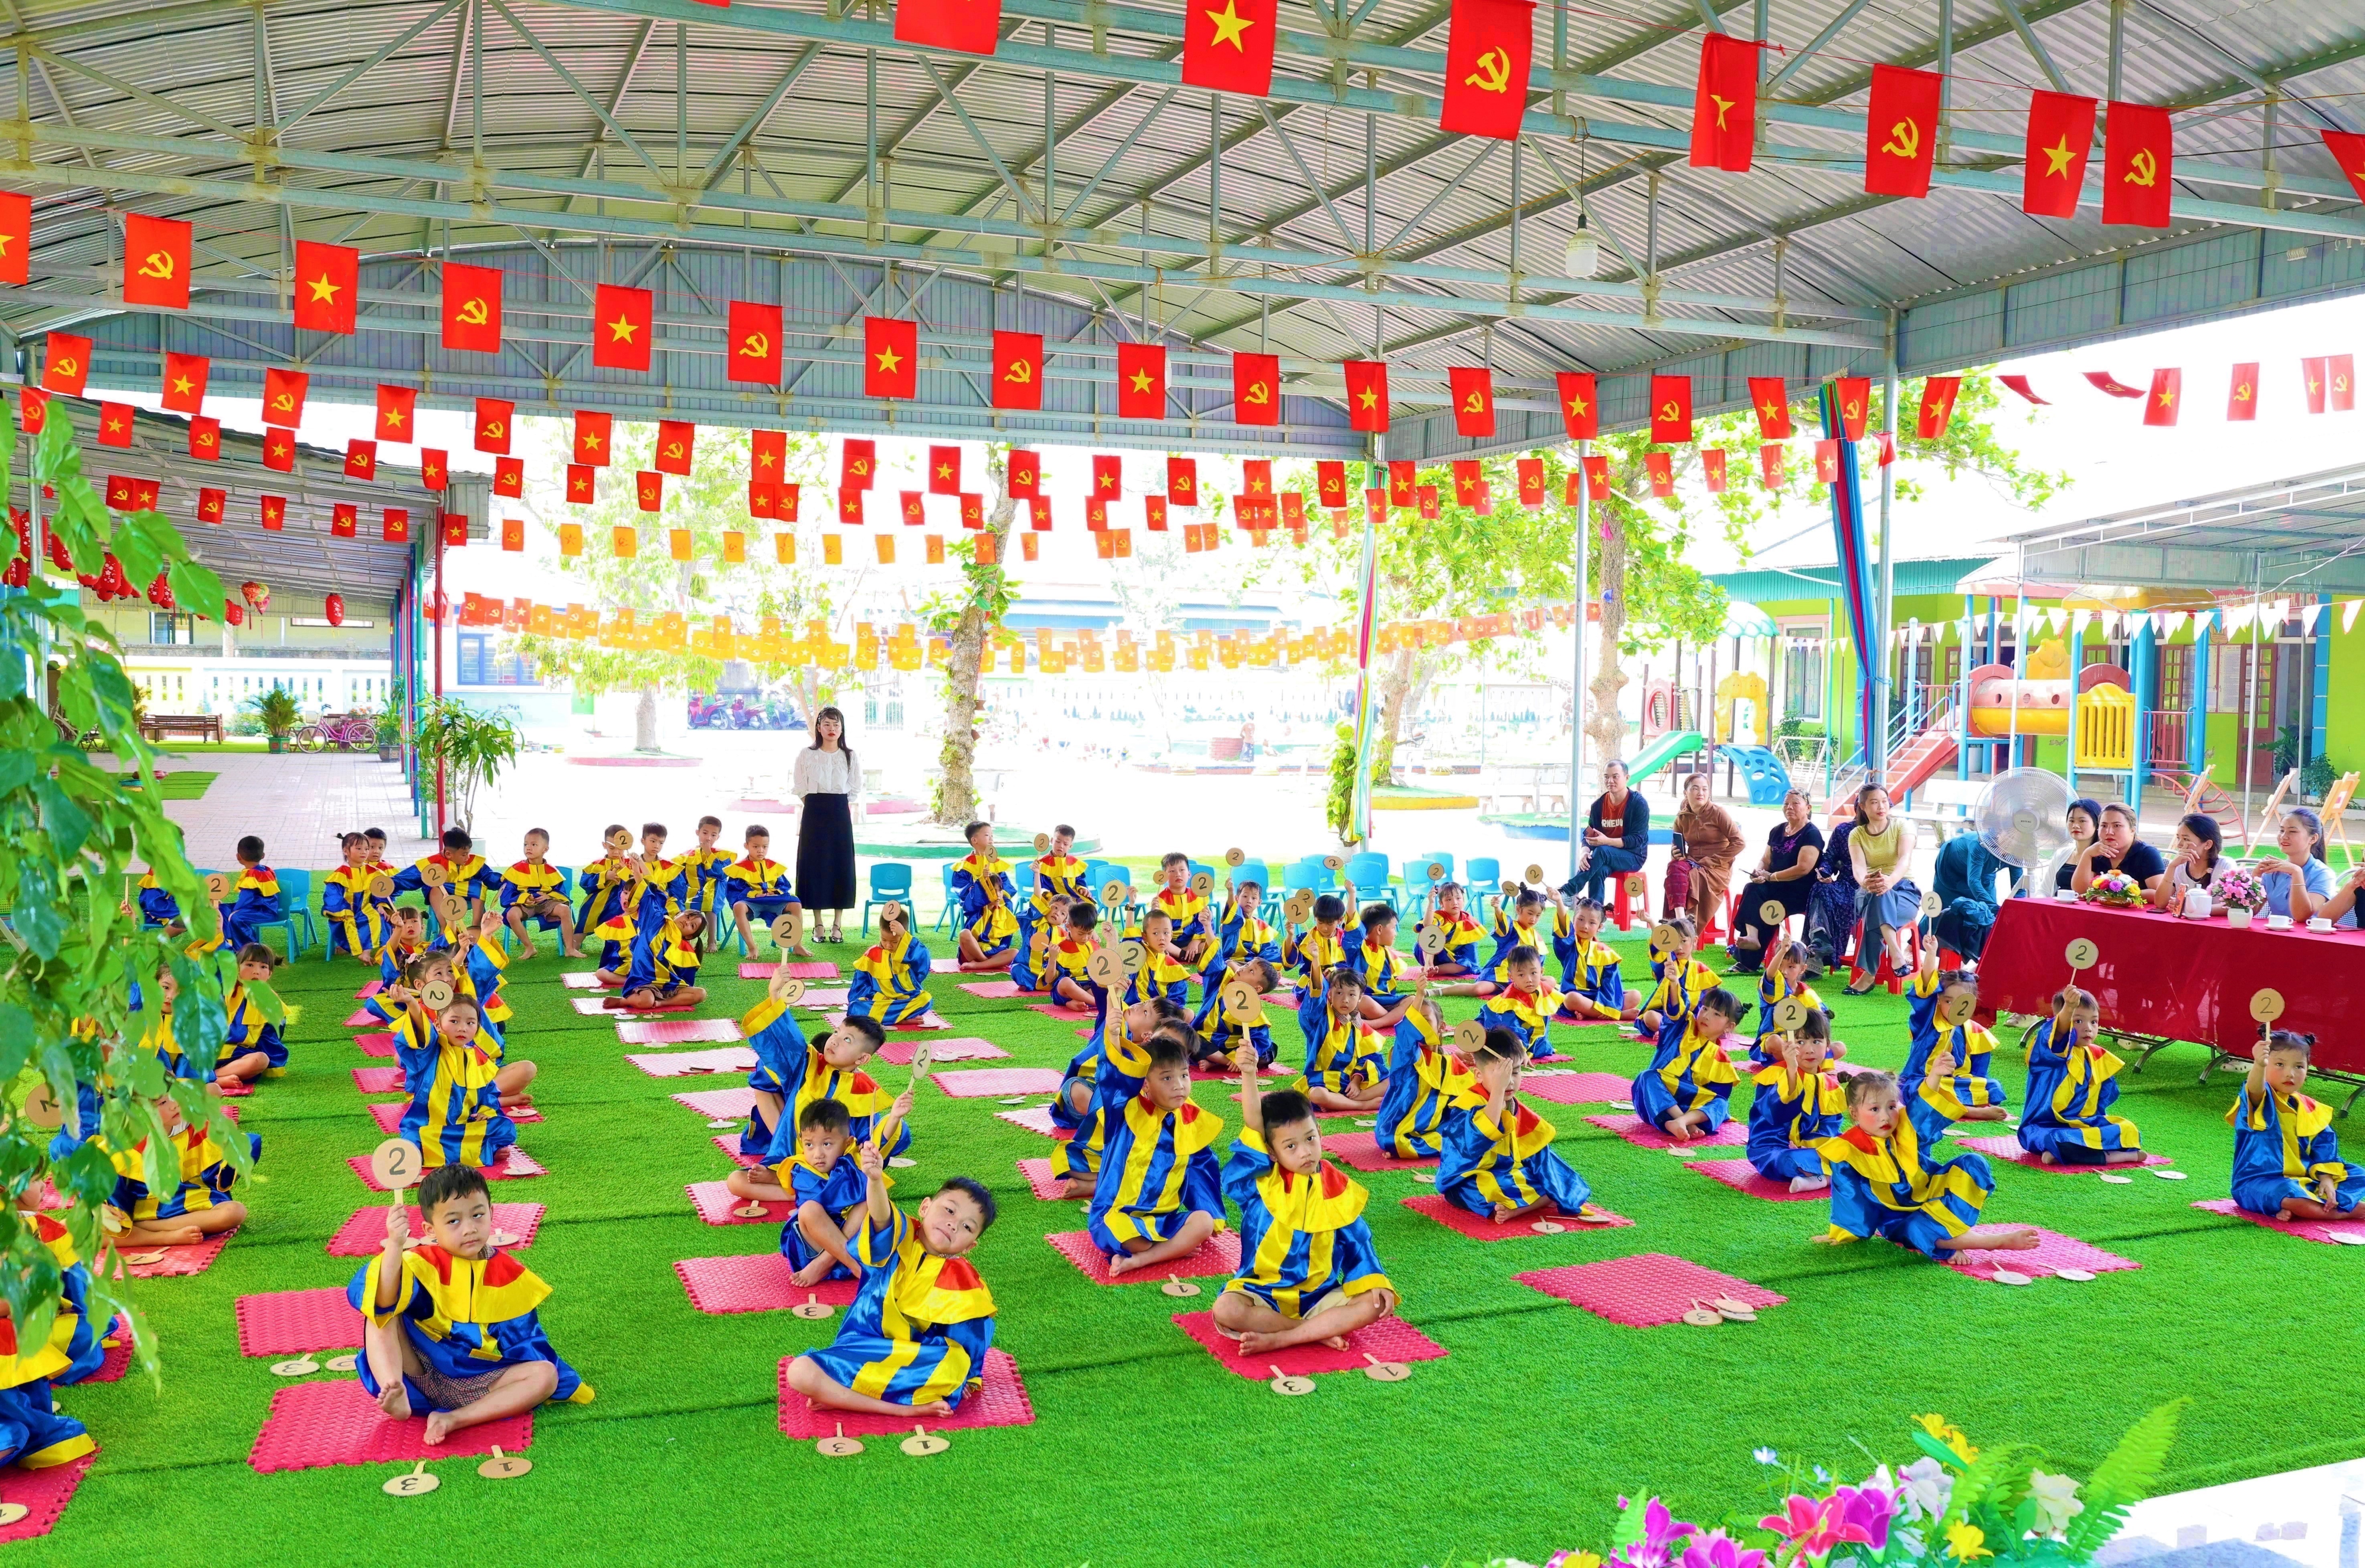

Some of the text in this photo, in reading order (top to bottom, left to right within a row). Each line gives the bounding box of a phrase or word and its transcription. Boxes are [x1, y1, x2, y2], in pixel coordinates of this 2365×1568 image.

[620, 836, 627, 845] 2
[1039, 839, 1044, 848] 2
[988, 848, 993, 858] 2
[428, 868, 440, 881] 2
[1433, 868, 1438, 876] 2
[1530, 870, 1539, 879] 2
[211, 878, 221, 892] 2
[377, 881, 386, 892] 2
[1199, 877, 1207, 889] 2
[1631, 882, 1637, 891] 2
[1109, 885, 1118, 901] 2
[1505, 886, 1514, 894] 2
[1302, 893, 1310, 903] 2
[1928, 897, 1936, 910] 2
[447, 899, 461, 915] 2
[888, 904, 894, 915] 2
[1292, 905, 1301, 916] 2
[1766, 905, 1778, 919] 2
[780, 921, 792, 939] 2
[1428, 934, 1436, 948] 2
[1661, 929, 1671, 944] 2
[1123, 948, 1138, 966] 2
[2075, 945, 2087, 960] 2
[1097, 956, 1111, 976] 2
[430, 991, 444, 1000] 2
[787, 985, 797, 996] 2
[1236, 990, 1248, 1009] 2
[1957, 1001, 1968, 1016] 2
[2260, 997, 2274, 1014] 2
[1786, 1005, 1796, 1020] 2
[1463, 1030, 1479, 1044] 2
[918, 1049, 927, 1068] 2
[389, 1148, 406, 1175] 2
[1176, 1285, 1188, 1293] 1
[804, 1307, 817, 1316] 3
[1696, 1312, 1708, 1321] 3
[282, 1364, 302, 1372] 3
[1381, 1366, 1398, 1376] 1
[1283, 1381, 1301, 1392] 3
[833, 1443, 845, 1453] 3
[917, 1441, 930, 1449] 1
[499, 1462, 513, 1471] 1
[401, 1478, 418, 1490] 3
